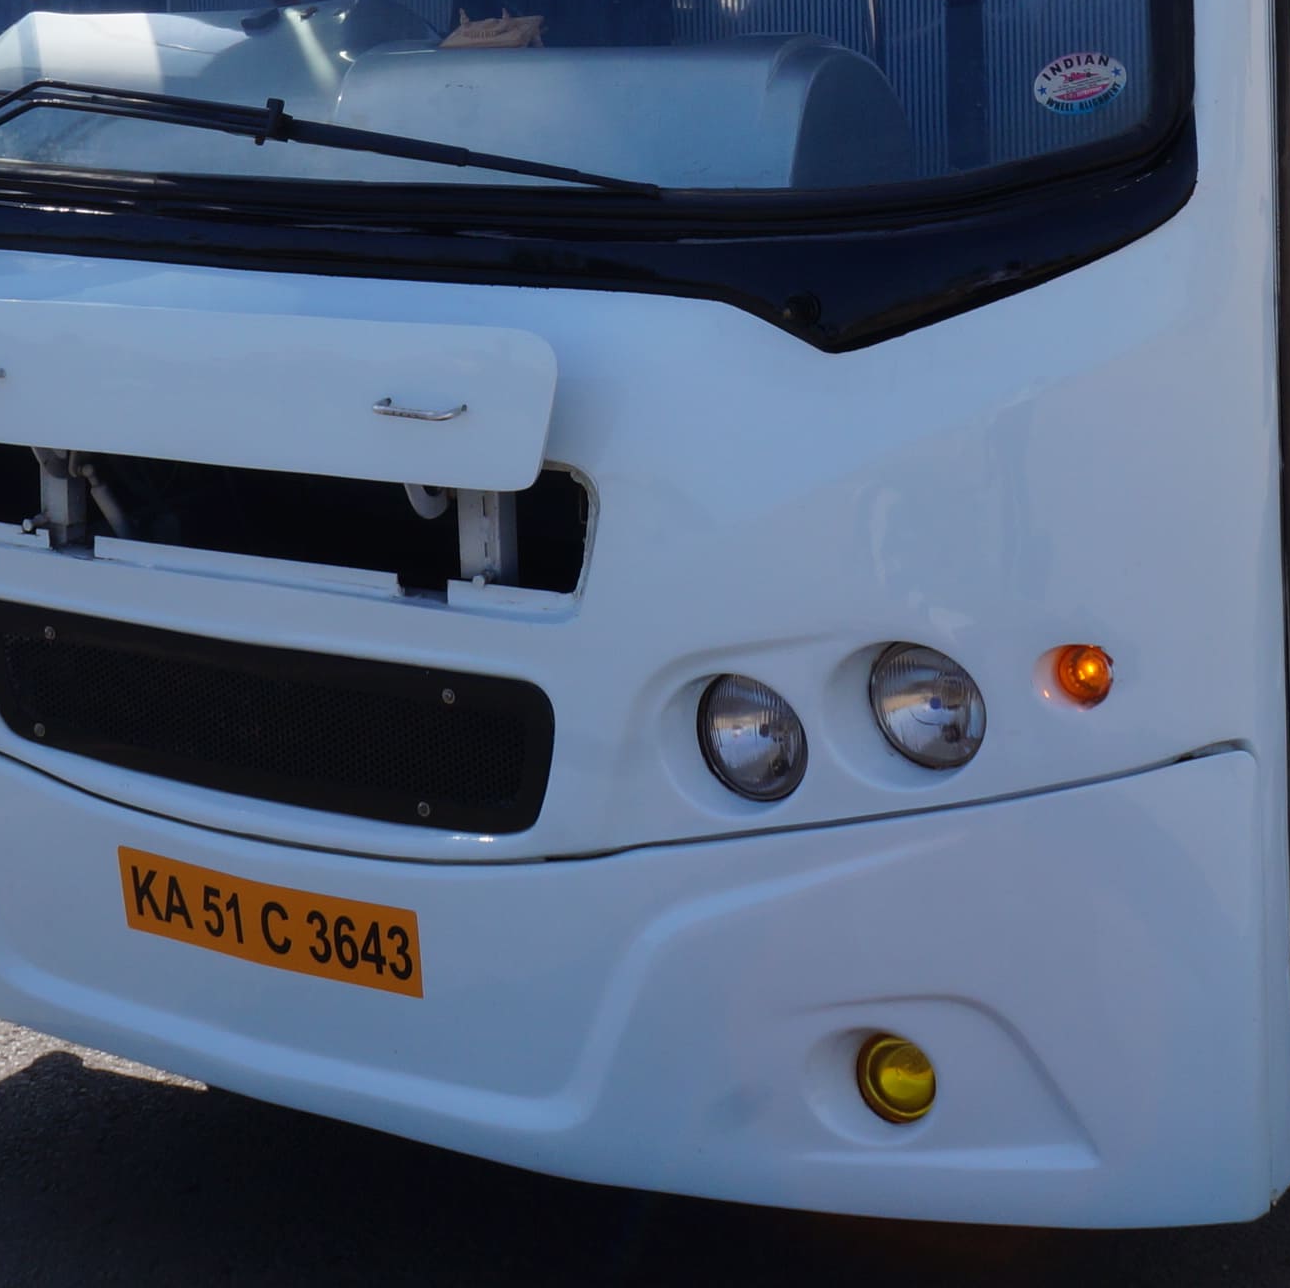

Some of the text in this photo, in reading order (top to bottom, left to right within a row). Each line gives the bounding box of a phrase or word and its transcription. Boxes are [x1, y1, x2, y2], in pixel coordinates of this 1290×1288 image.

[1042, 54, 1110, 81] INDIAN
[131, 865, 413, 980] KA 51 C 3643
